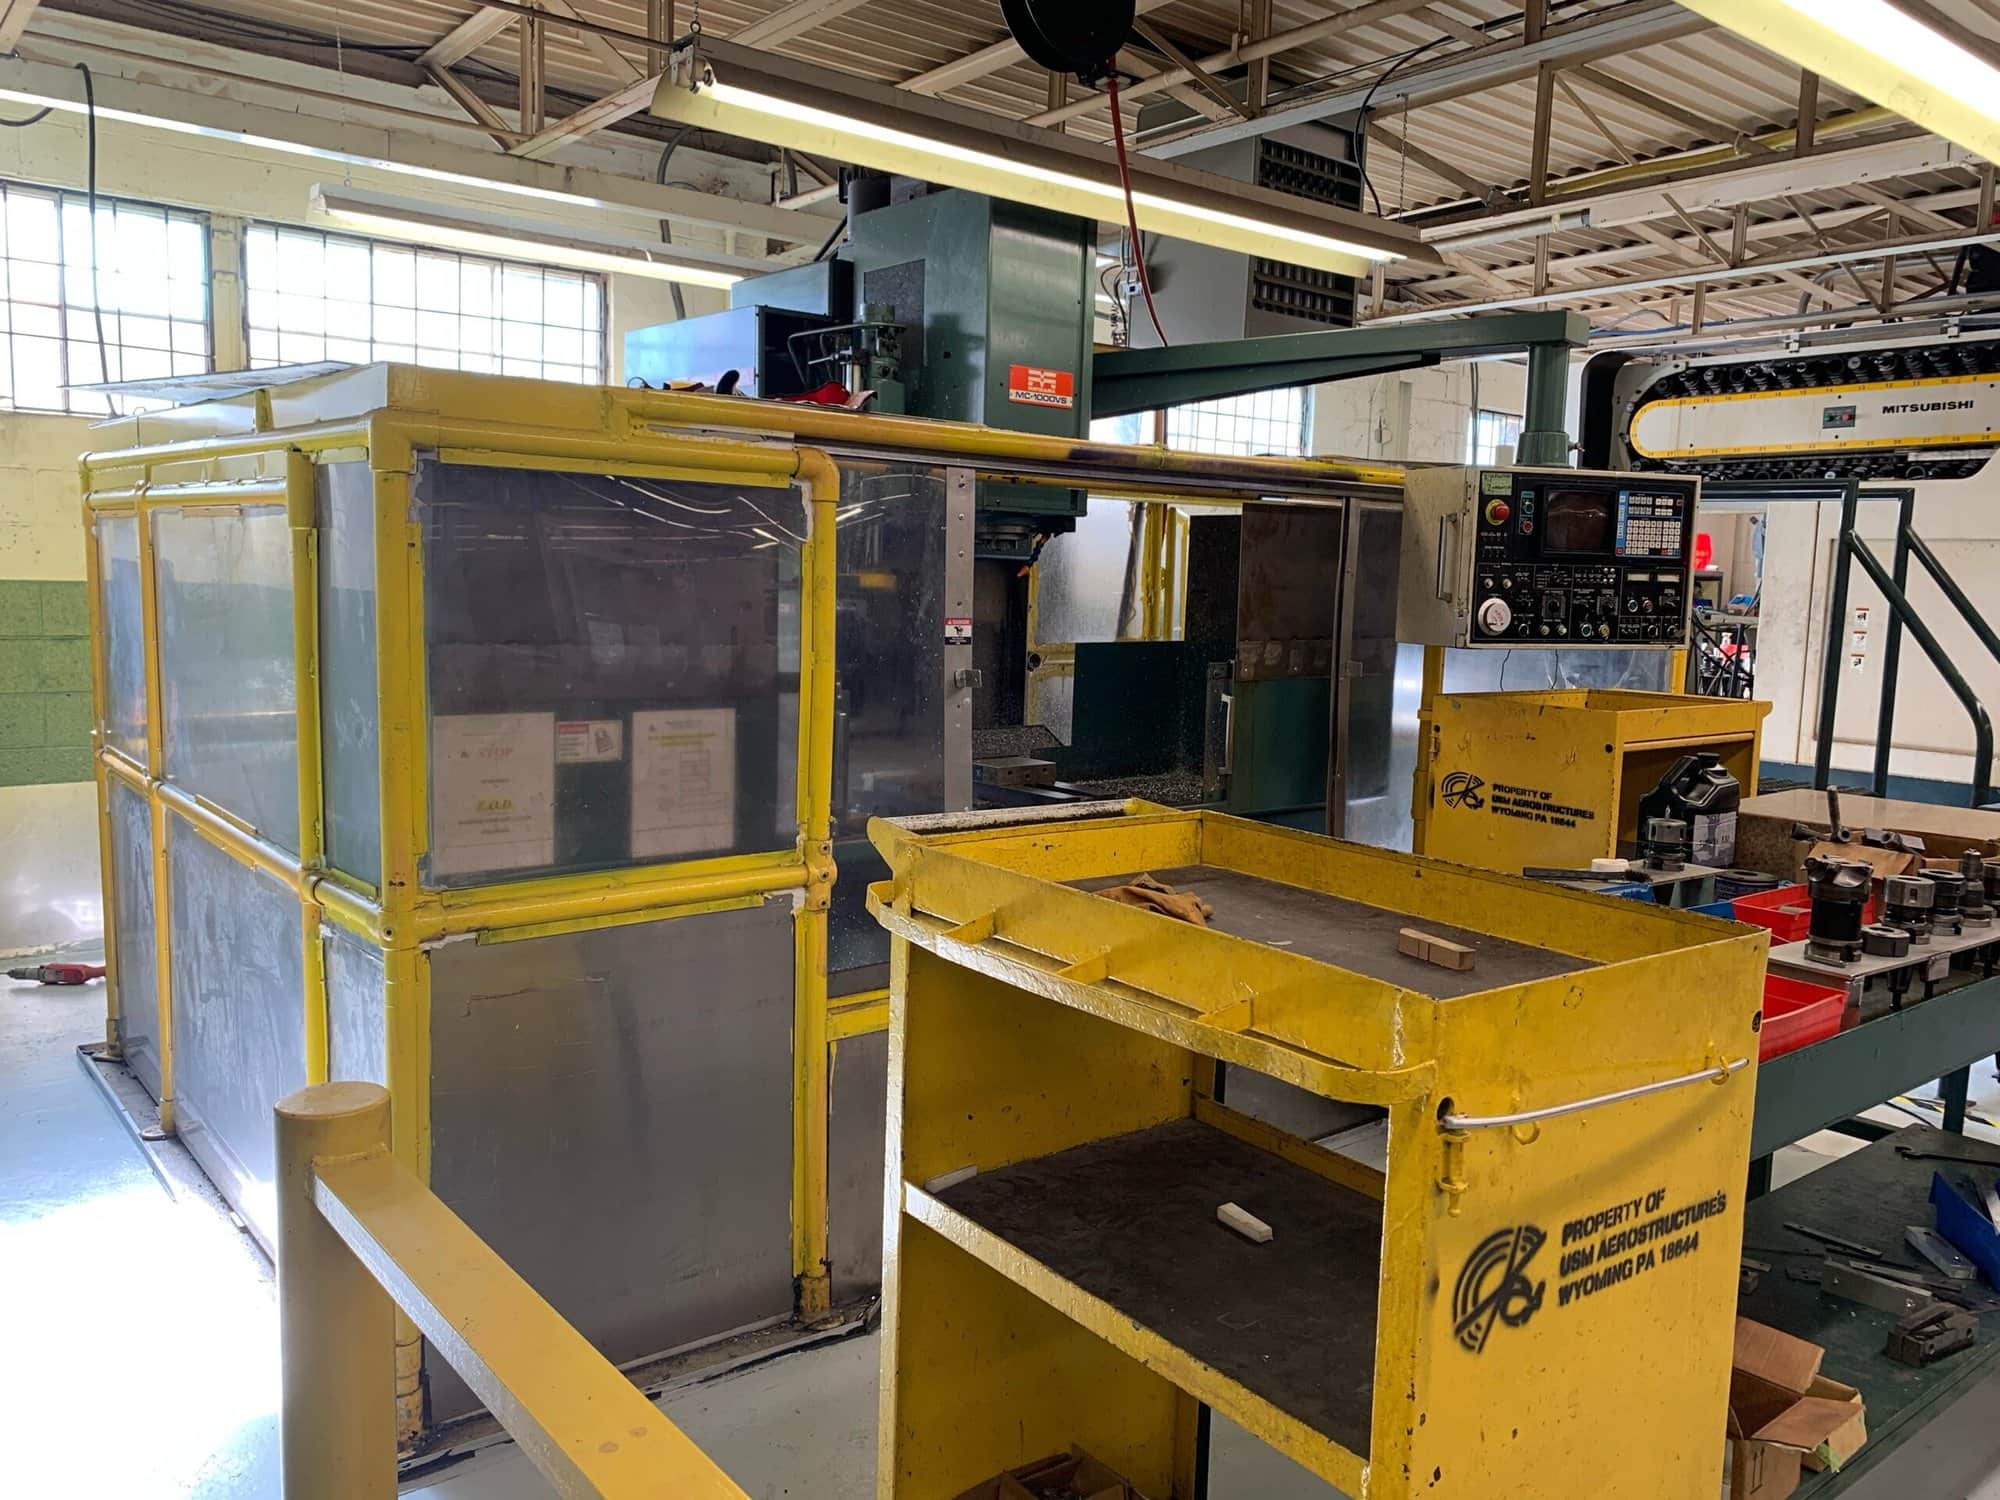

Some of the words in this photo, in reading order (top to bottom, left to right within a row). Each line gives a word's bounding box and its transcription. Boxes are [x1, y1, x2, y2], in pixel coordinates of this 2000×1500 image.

[1015, 391, 1067, 404] MC-1000VS
[1882, 400, 1975, 414] MITSUBISHI
[1492, 784, 1538, 799] PROPERTY
[1540, 792, 1552, 800] OF
[1491, 806, 1533, 820] WYOMING
[1535, 812, 1547, 824] PA
[1561, 1197, 1643, 1247] PROPERTY
[1645, 1188, 1666, 1214] OF
[1559, 1244, 1594, 1279] USM
[1558, 1258, 1633, 1307] WYOMING
[1635, 1248, 1655, 1275] PA
